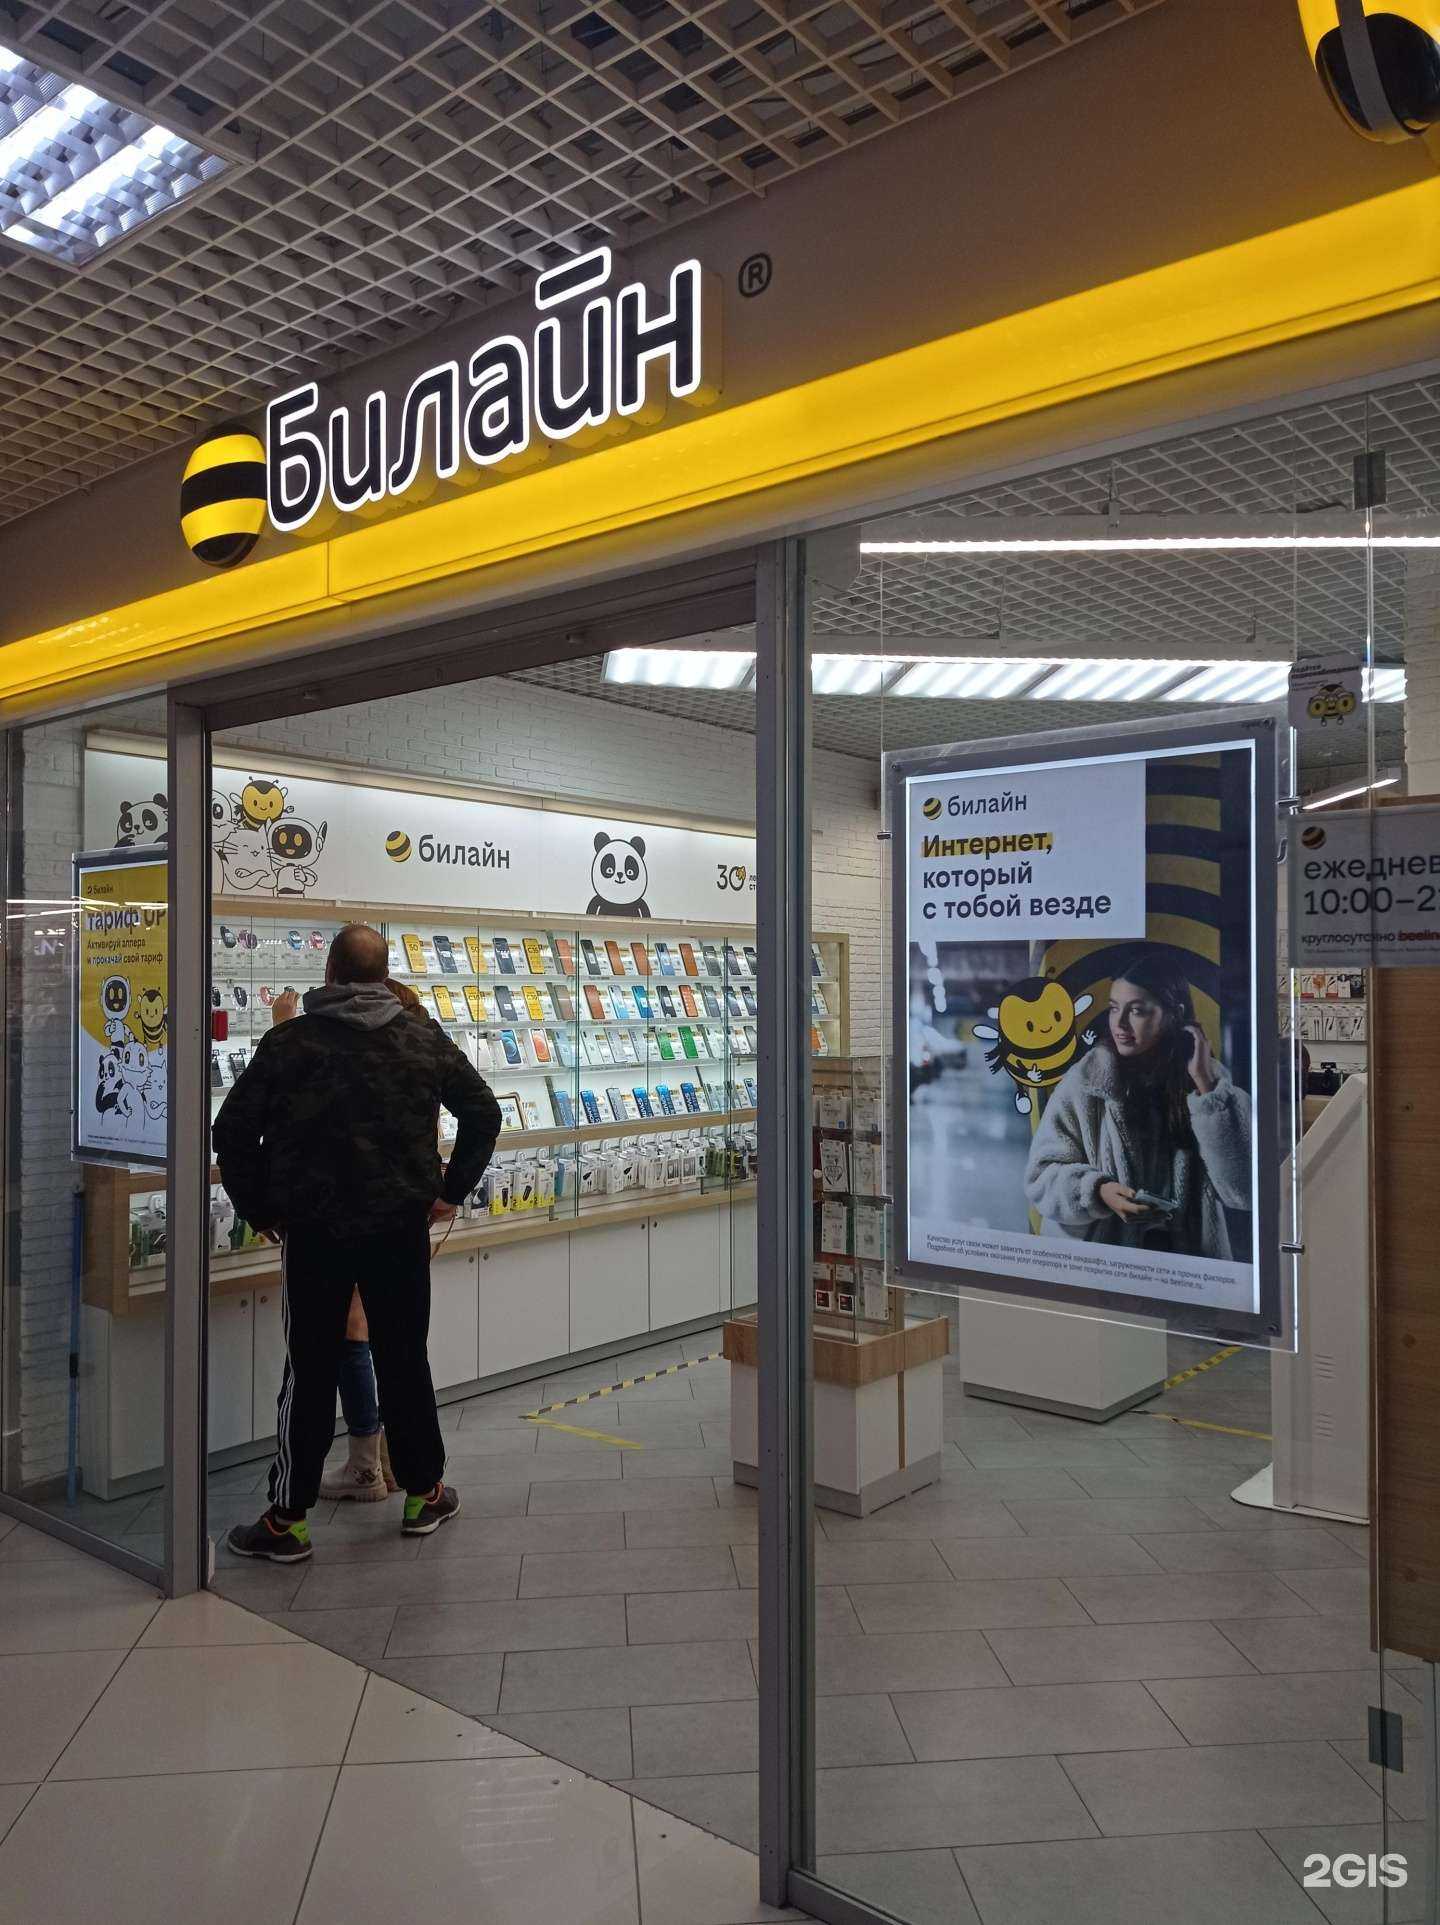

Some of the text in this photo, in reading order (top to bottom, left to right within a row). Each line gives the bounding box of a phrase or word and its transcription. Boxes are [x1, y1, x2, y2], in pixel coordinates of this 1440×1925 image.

[947, 792, 1027, 817] билайн
[418, 834, 510, 870] билайн
[923, 832, 1053, 860] Интернет,
[717, 864, 746, 892] 30
[923, 862, 1032, 892] который
[87, 907, 140, 936] тариф
[923, 895, 1112, 920] с тобой везде
[87, 938, 121, 951] Активируй
[92, 953, 122, 967] прокачай
[123, 952, 140, 964] свой
[141, 951, 164, 965] тариф
